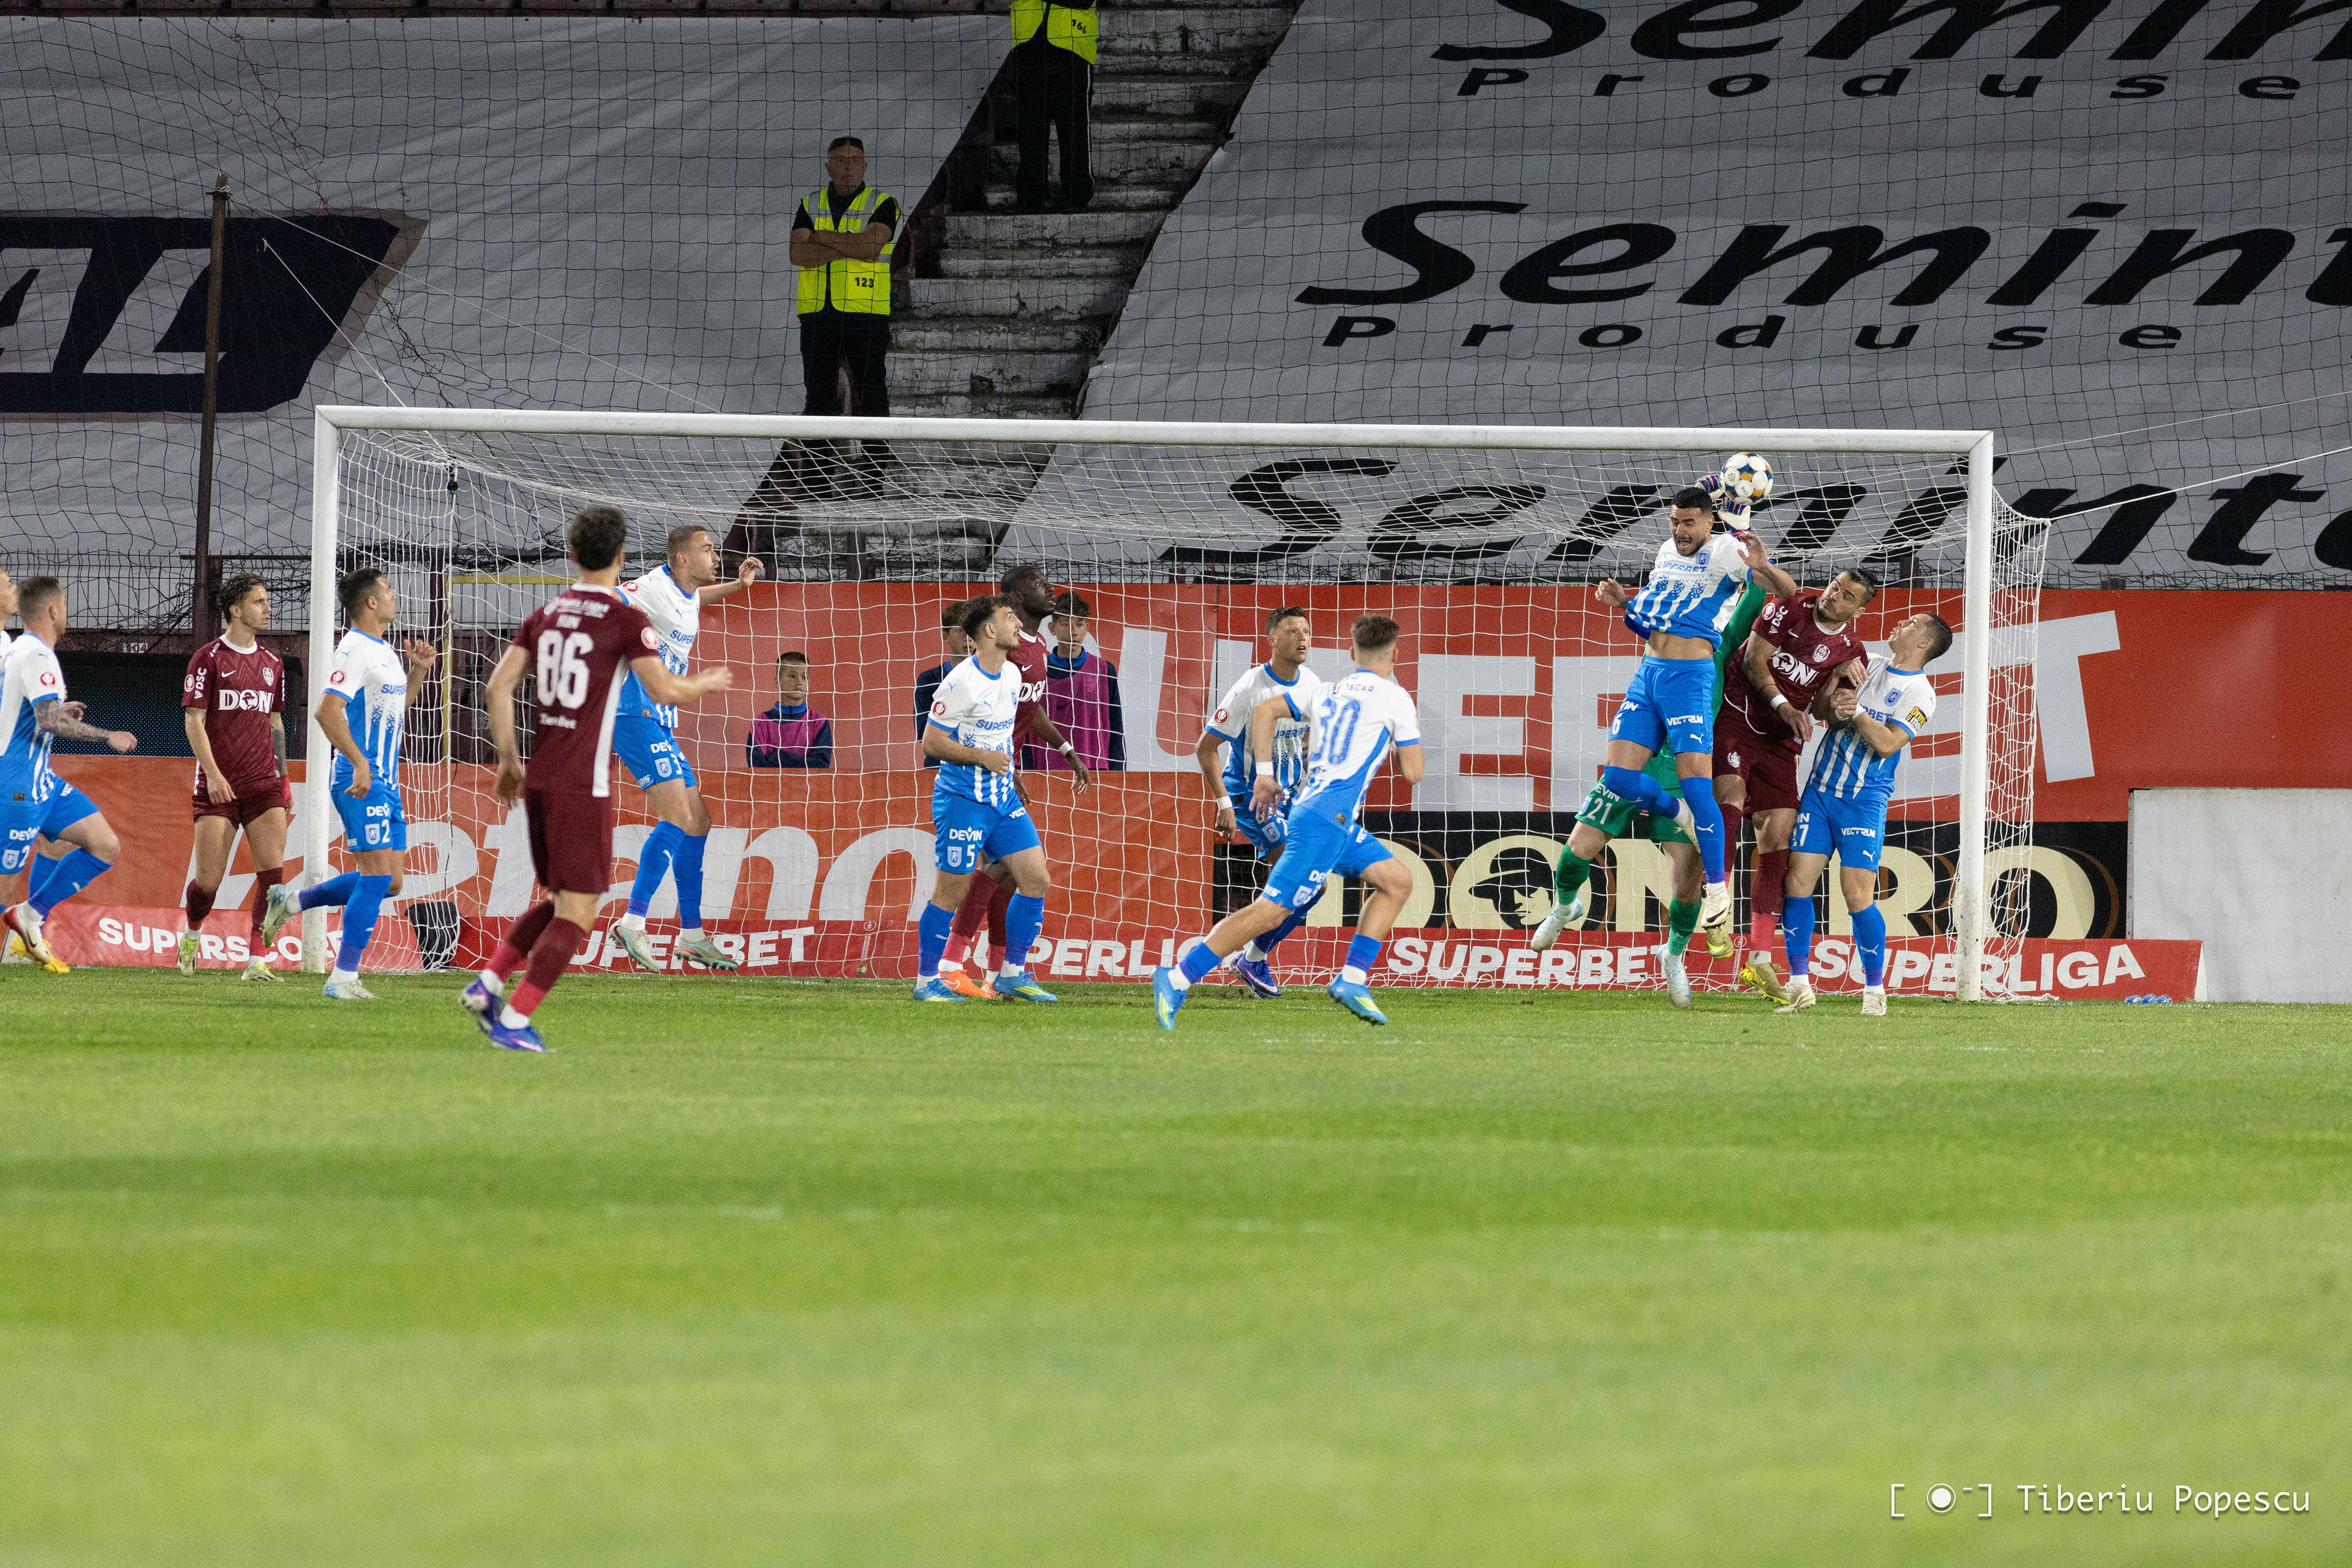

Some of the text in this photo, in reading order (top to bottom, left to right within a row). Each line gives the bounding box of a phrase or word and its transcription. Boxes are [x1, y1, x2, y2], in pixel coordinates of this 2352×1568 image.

[1071, 19, 1087, 34] 166
[1457, 67, 2301, 100] Produse
[854, 277, 874, 288] 123
[1322, 315, 2182, 350] Produse
[1771, 606, 1789, 627] DSC
[537, 629, 594, 709] 86
[1770, 646, 1820, 687] ON
[195, 668, 207, 690] DSC
[1018, 676, 1046, 703] DO
[218, 690, 274, 714] DON
[1308, 698, 1361, 765] 30
[1611, 713, 1623, 735] 6
[1667, 715, 1703, 726] VECTRUM
[650, 739, 673, 753] DEV
[1594, 782, 1621, 802] EVIN
[366, 802, 391, 818] DEV
[1585, 797, 1613, 825] 21
[382, 819, 391, 843] 2
[949, 826, 983, 842] DEVIN
[1841, 827, 1875, 838] VECTRUM
[966, 844, 976, 868] 5
[99, 918, 344, 962] SUPRSOR
